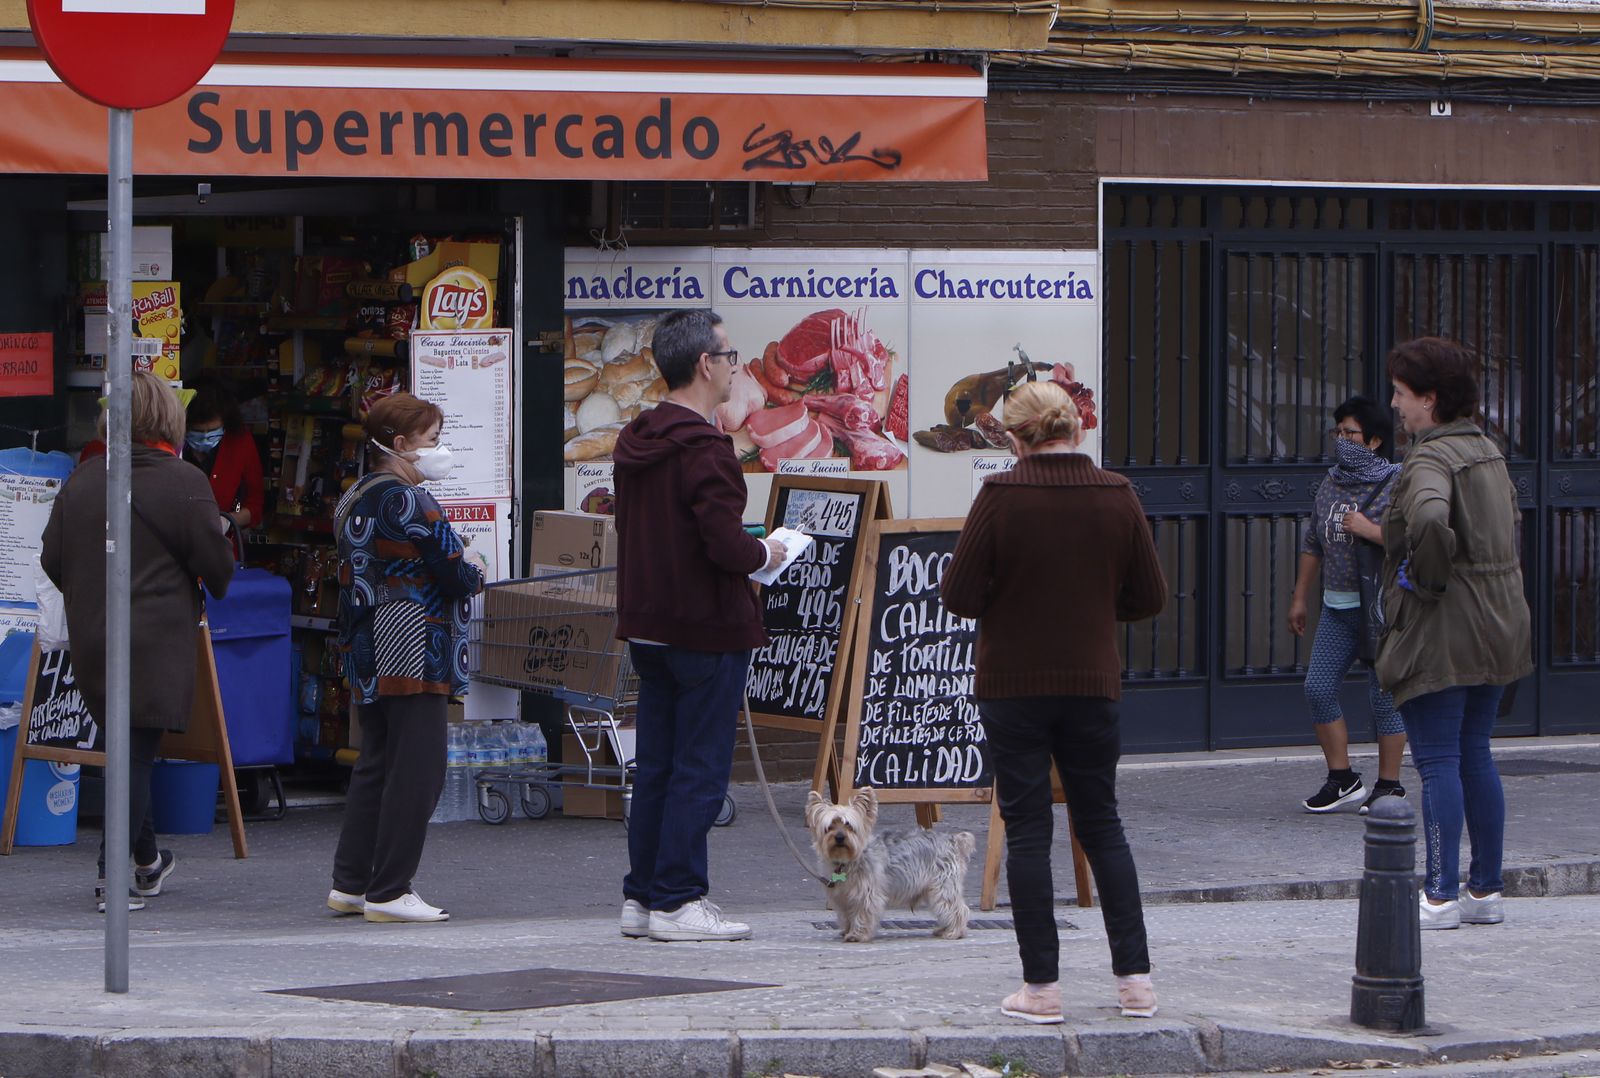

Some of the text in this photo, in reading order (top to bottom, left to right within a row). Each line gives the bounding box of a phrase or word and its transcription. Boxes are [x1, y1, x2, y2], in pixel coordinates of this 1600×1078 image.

[187, 91, 720, 171] Supermercado
[564, 266, 704, 300] nadería
[723, 266, 899, 299] Carnicería
[914, 268, 1094, 300] Charcutería
[141, 311, 166, 325] Cheese
[431, 286, 485, 327] Lay's
[420, 337, 445, 347] Casa
[433, 347, 490, 357] Baguettes Calientes
[576, 464, 603, 476] Casa
[780, 460, 847, 473] Casa Lucinio
[973, 458, 998, 470] Casa
[444, 507, 490, 520] FERTA
[460, 522, 492, 533] Lucinio
[1333, 532, 1347, 543] LATE
[818, 542, 844, 565] DE
[777, 563, 831, 587] CERDO
[815, 636, 839, 667] DE
[870, 649, 893, 675] DE
[746, 664, 772, 701] PAVO
[864, 677, 887, 699] DE
[893, 674, 936, 699] LOMO
[861, 701, 884, 725] DE
[860, 726, 882, 747] DE
[931, 726, 946, 742] DE
[855, 749, 870, 783] DE
